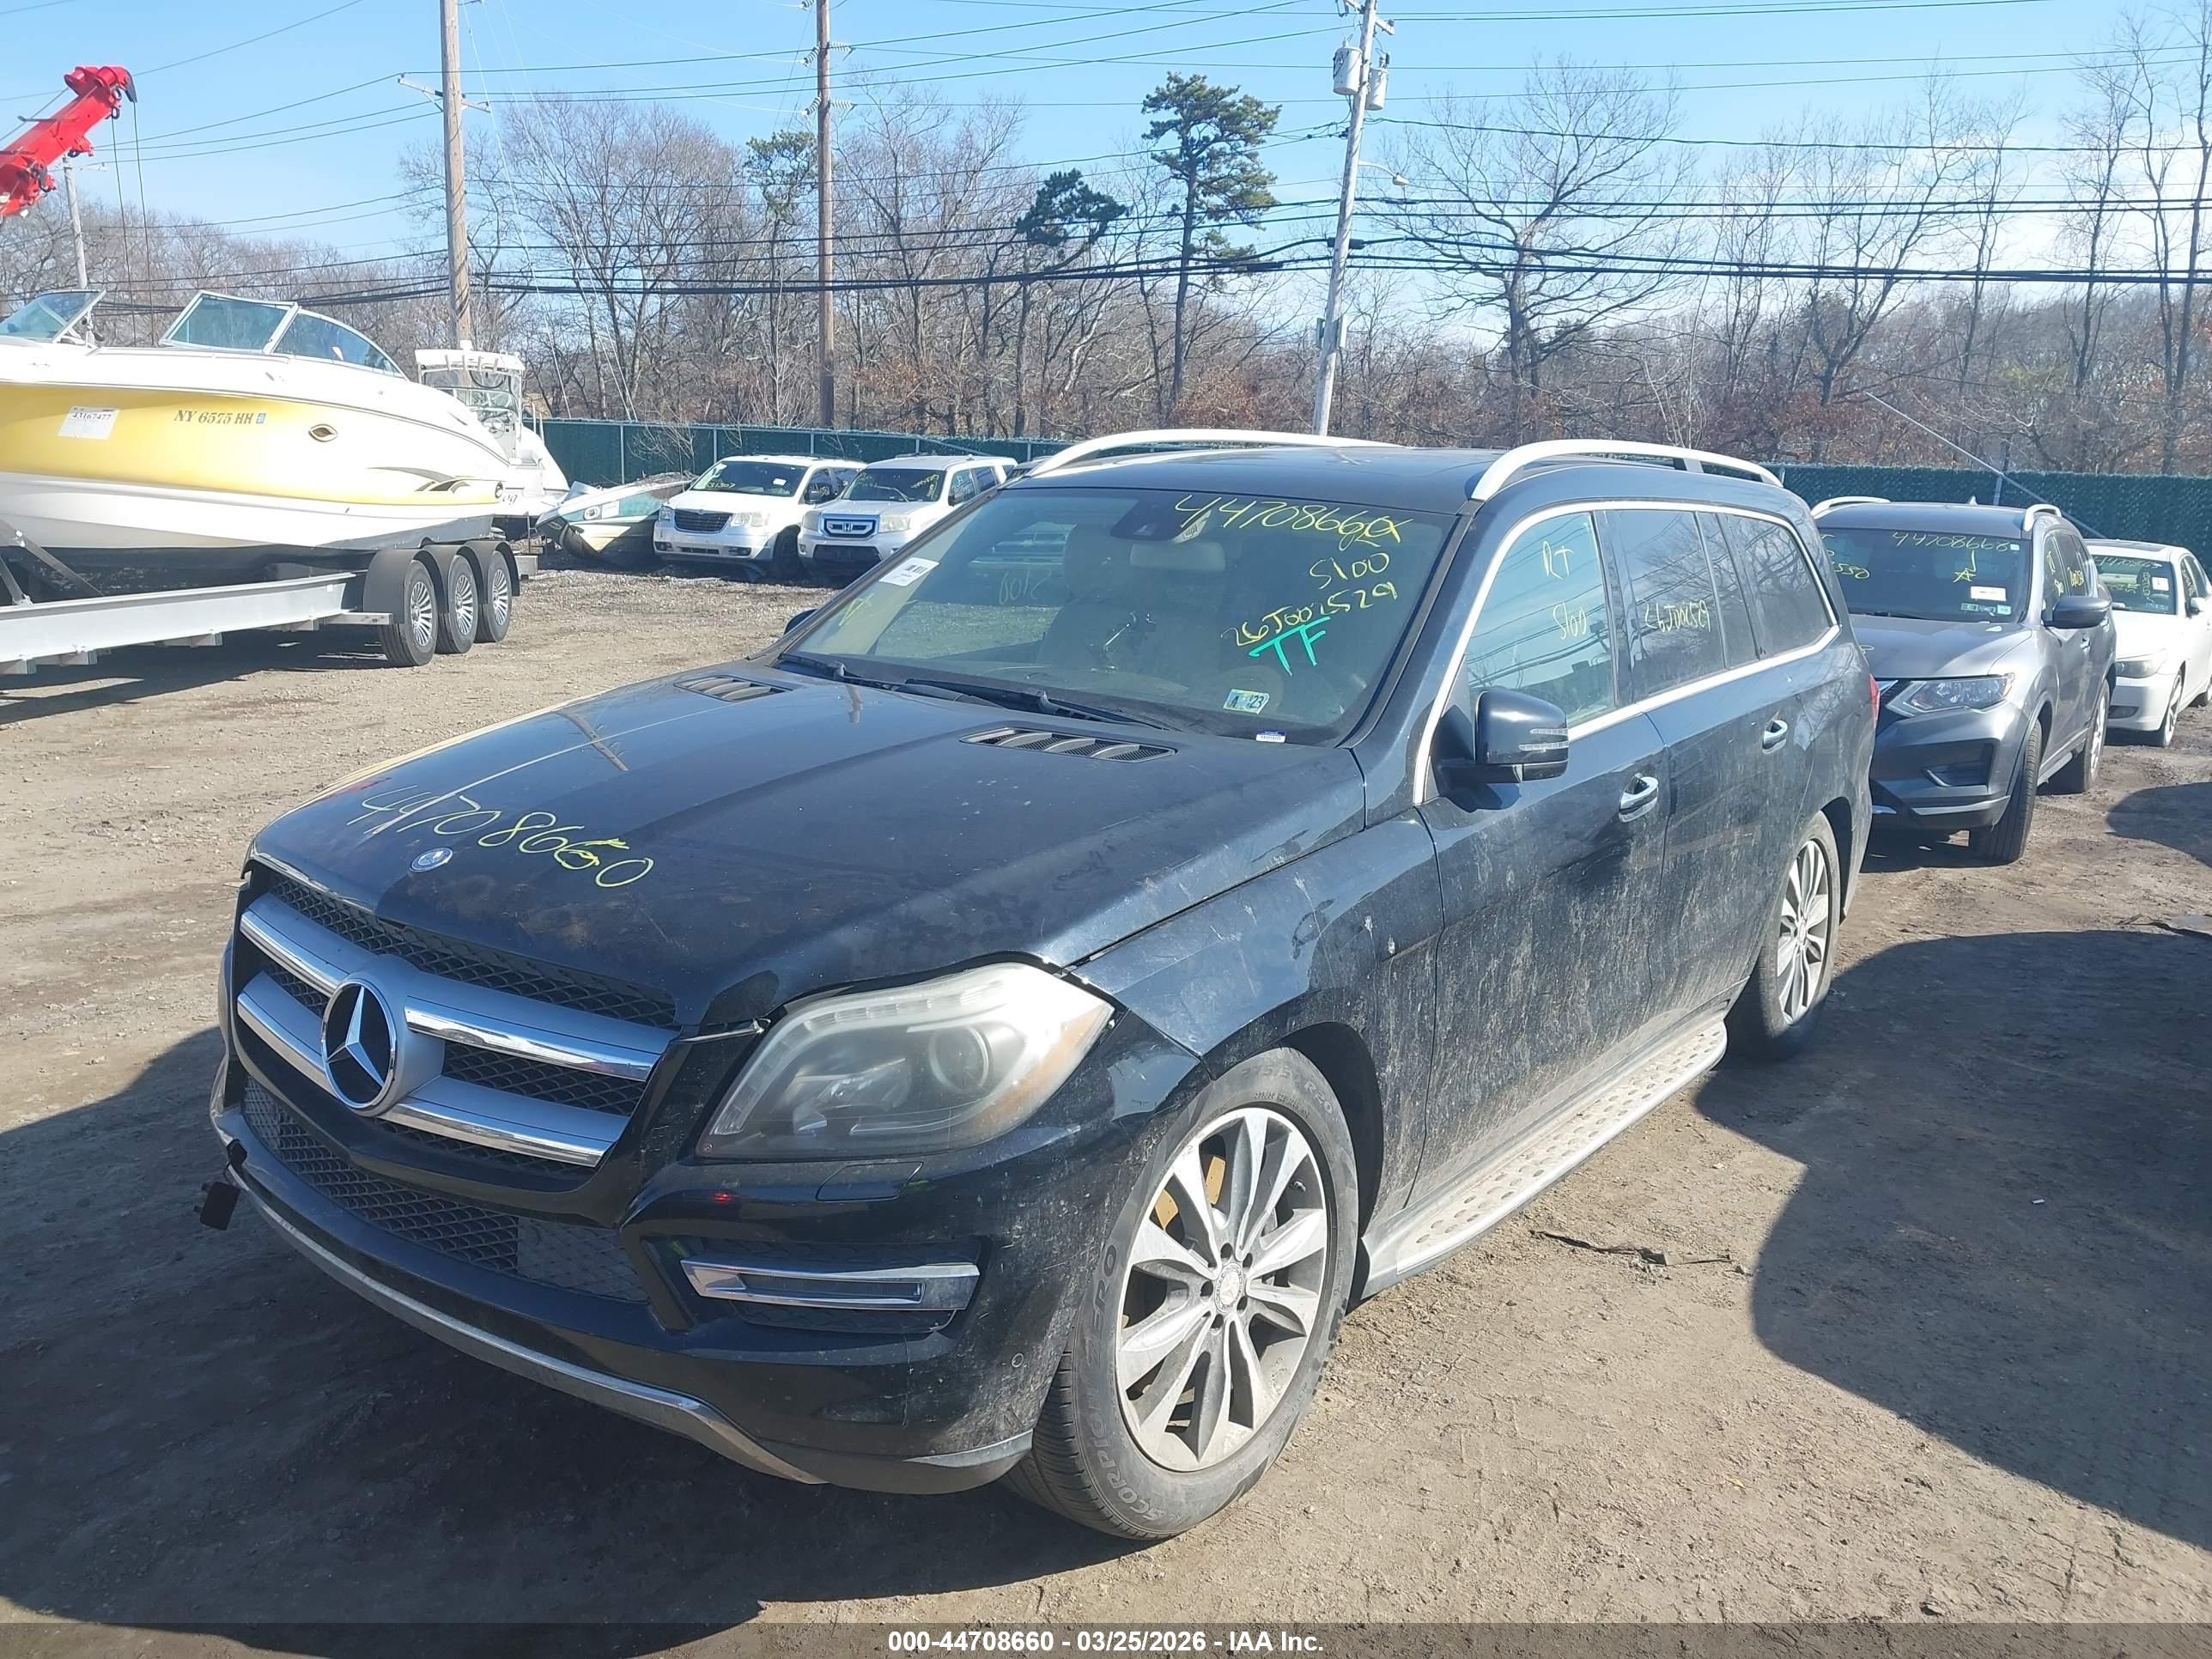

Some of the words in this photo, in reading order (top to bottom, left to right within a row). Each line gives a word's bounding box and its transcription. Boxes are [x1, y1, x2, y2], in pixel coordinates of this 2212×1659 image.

[173, 410, 198, 422] NY
[198, 412, 234, 424] 6575
[234, 413, 255, 424] HH
[1248, 616, 1333, 677] TF
[1085, 1386, 1163, 1522] SCORPION
